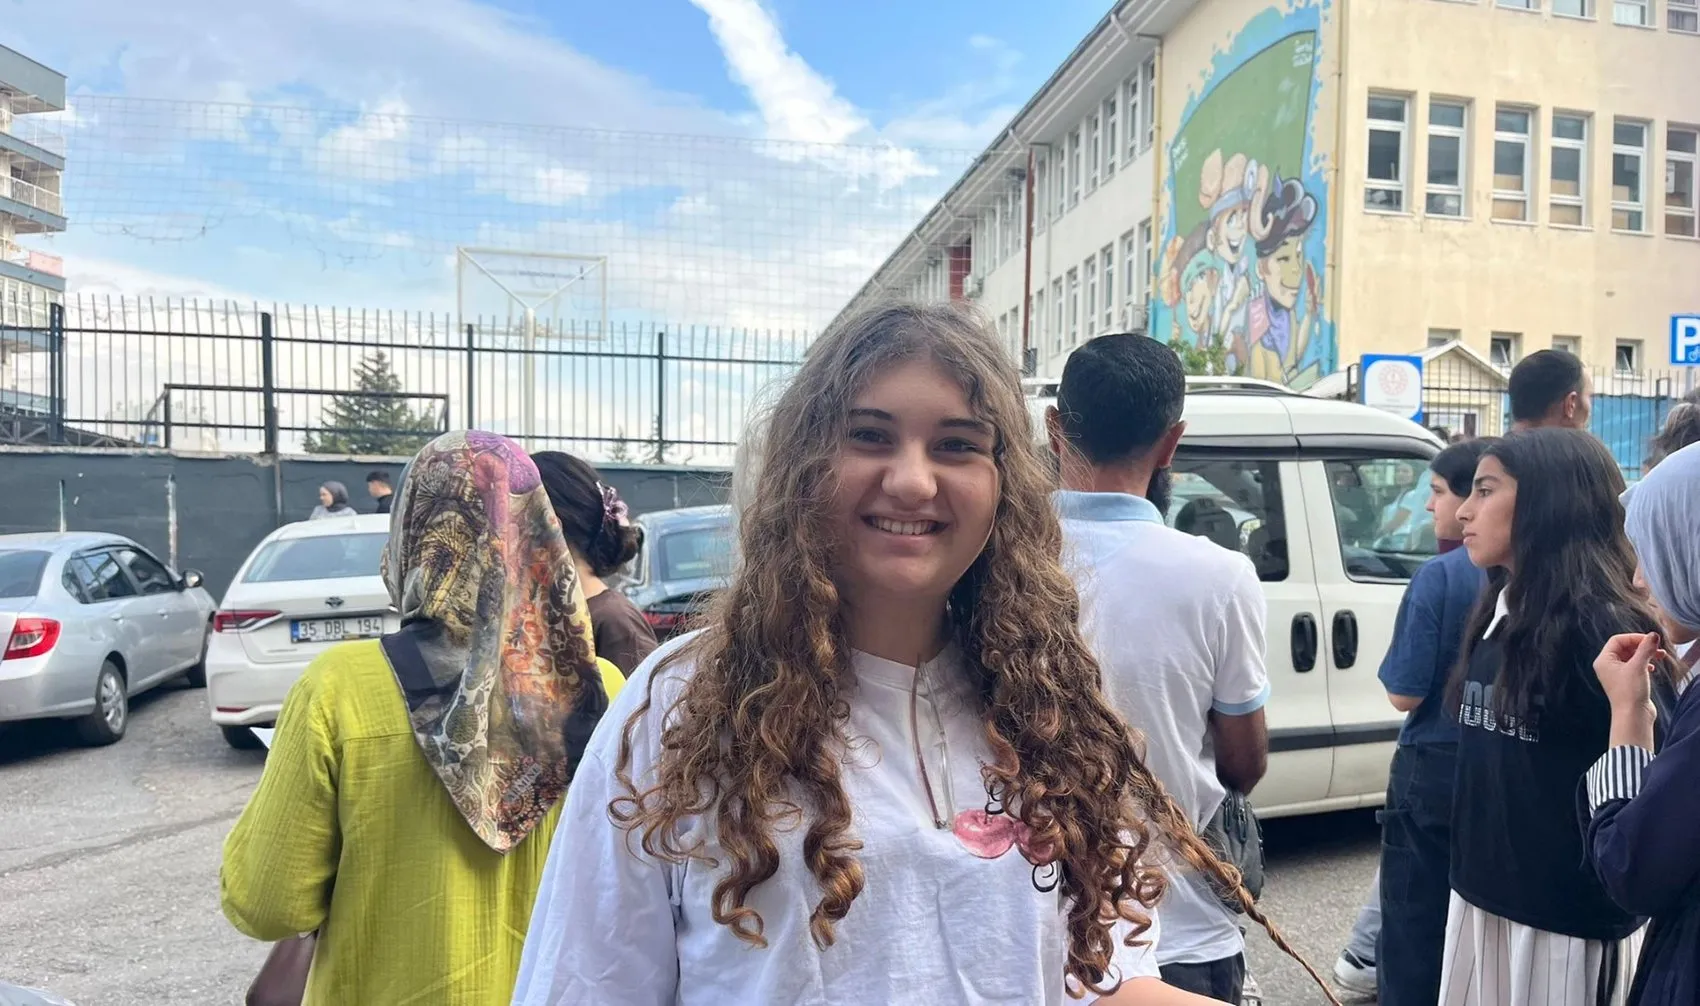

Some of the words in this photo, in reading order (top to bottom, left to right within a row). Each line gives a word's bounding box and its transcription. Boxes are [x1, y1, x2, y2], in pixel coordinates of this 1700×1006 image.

[1676, 318, 1700, 361] P
[300, 622, 317, 638] 35
[324, 619, 349, 635] DBL
[357, 618, 380, 632] 194
